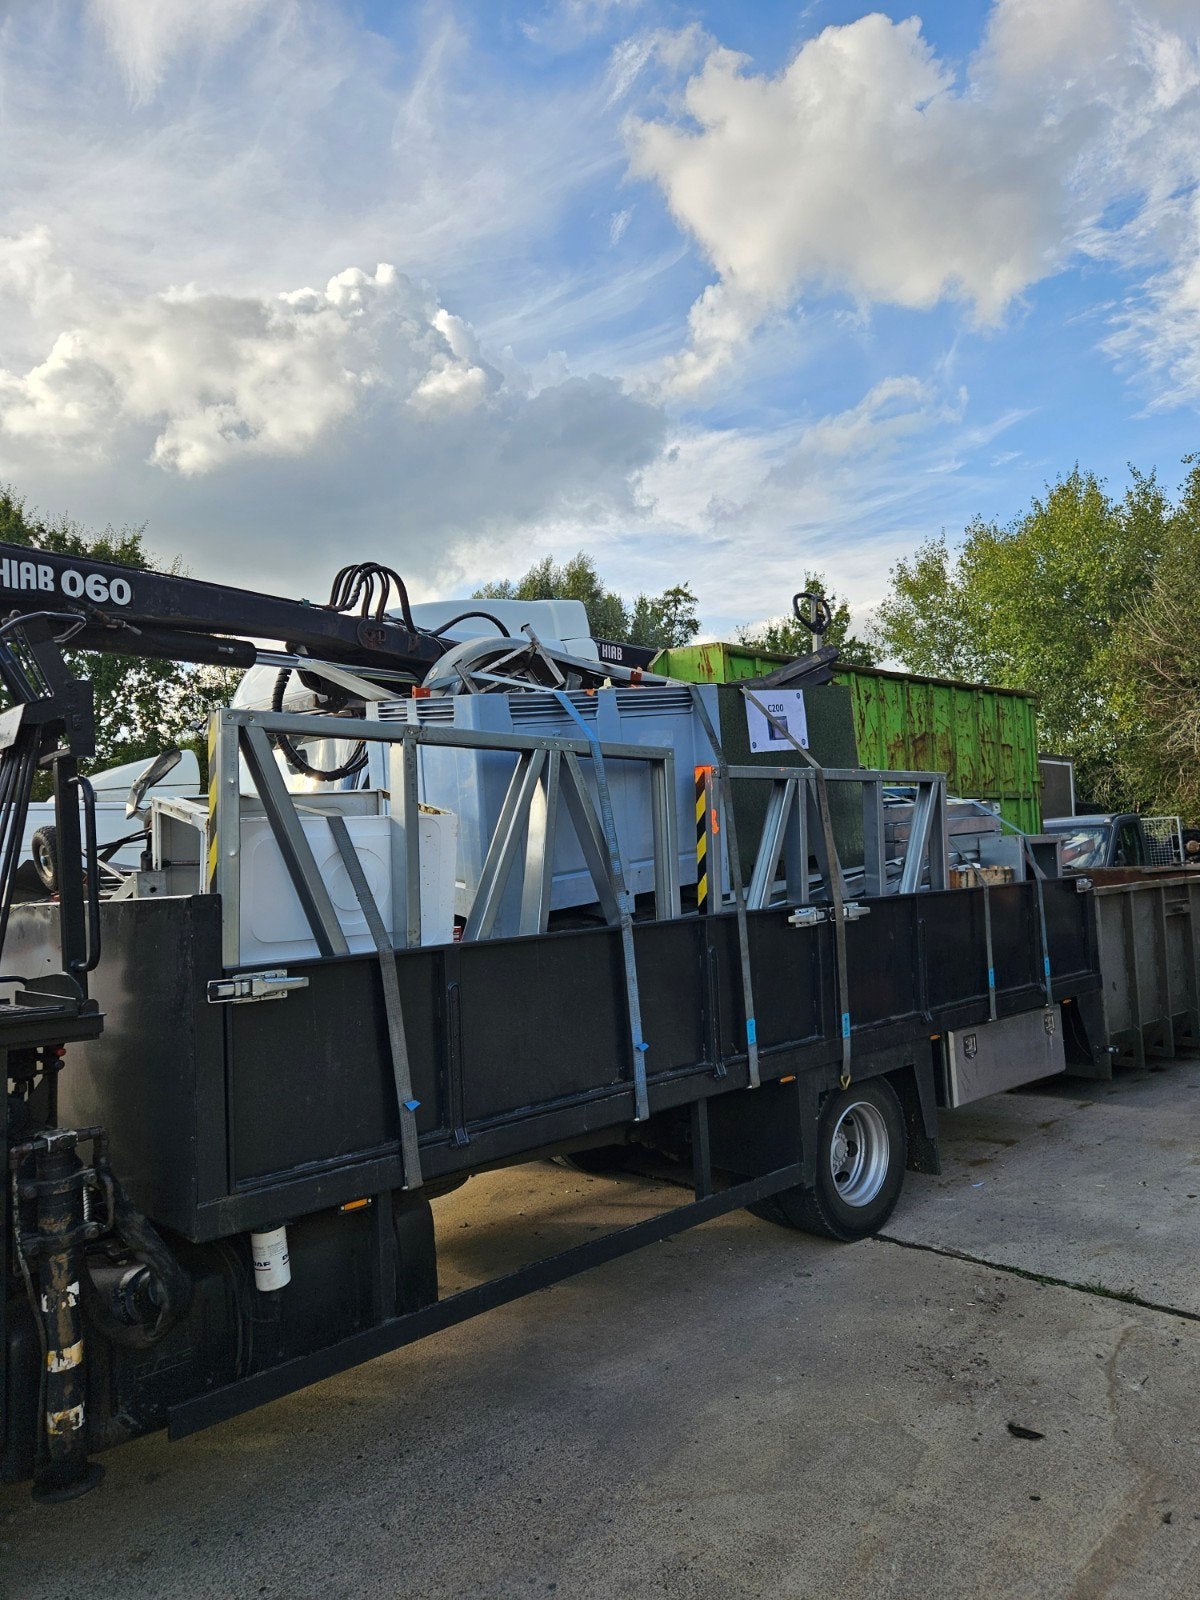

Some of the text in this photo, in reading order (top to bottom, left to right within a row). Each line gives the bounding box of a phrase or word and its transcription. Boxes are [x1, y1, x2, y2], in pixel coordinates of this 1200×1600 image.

[0, 558, 132, 605] HIAB 060
[601, 643, 623, 661] HIAB
[767, 703, 784, 713] C200
